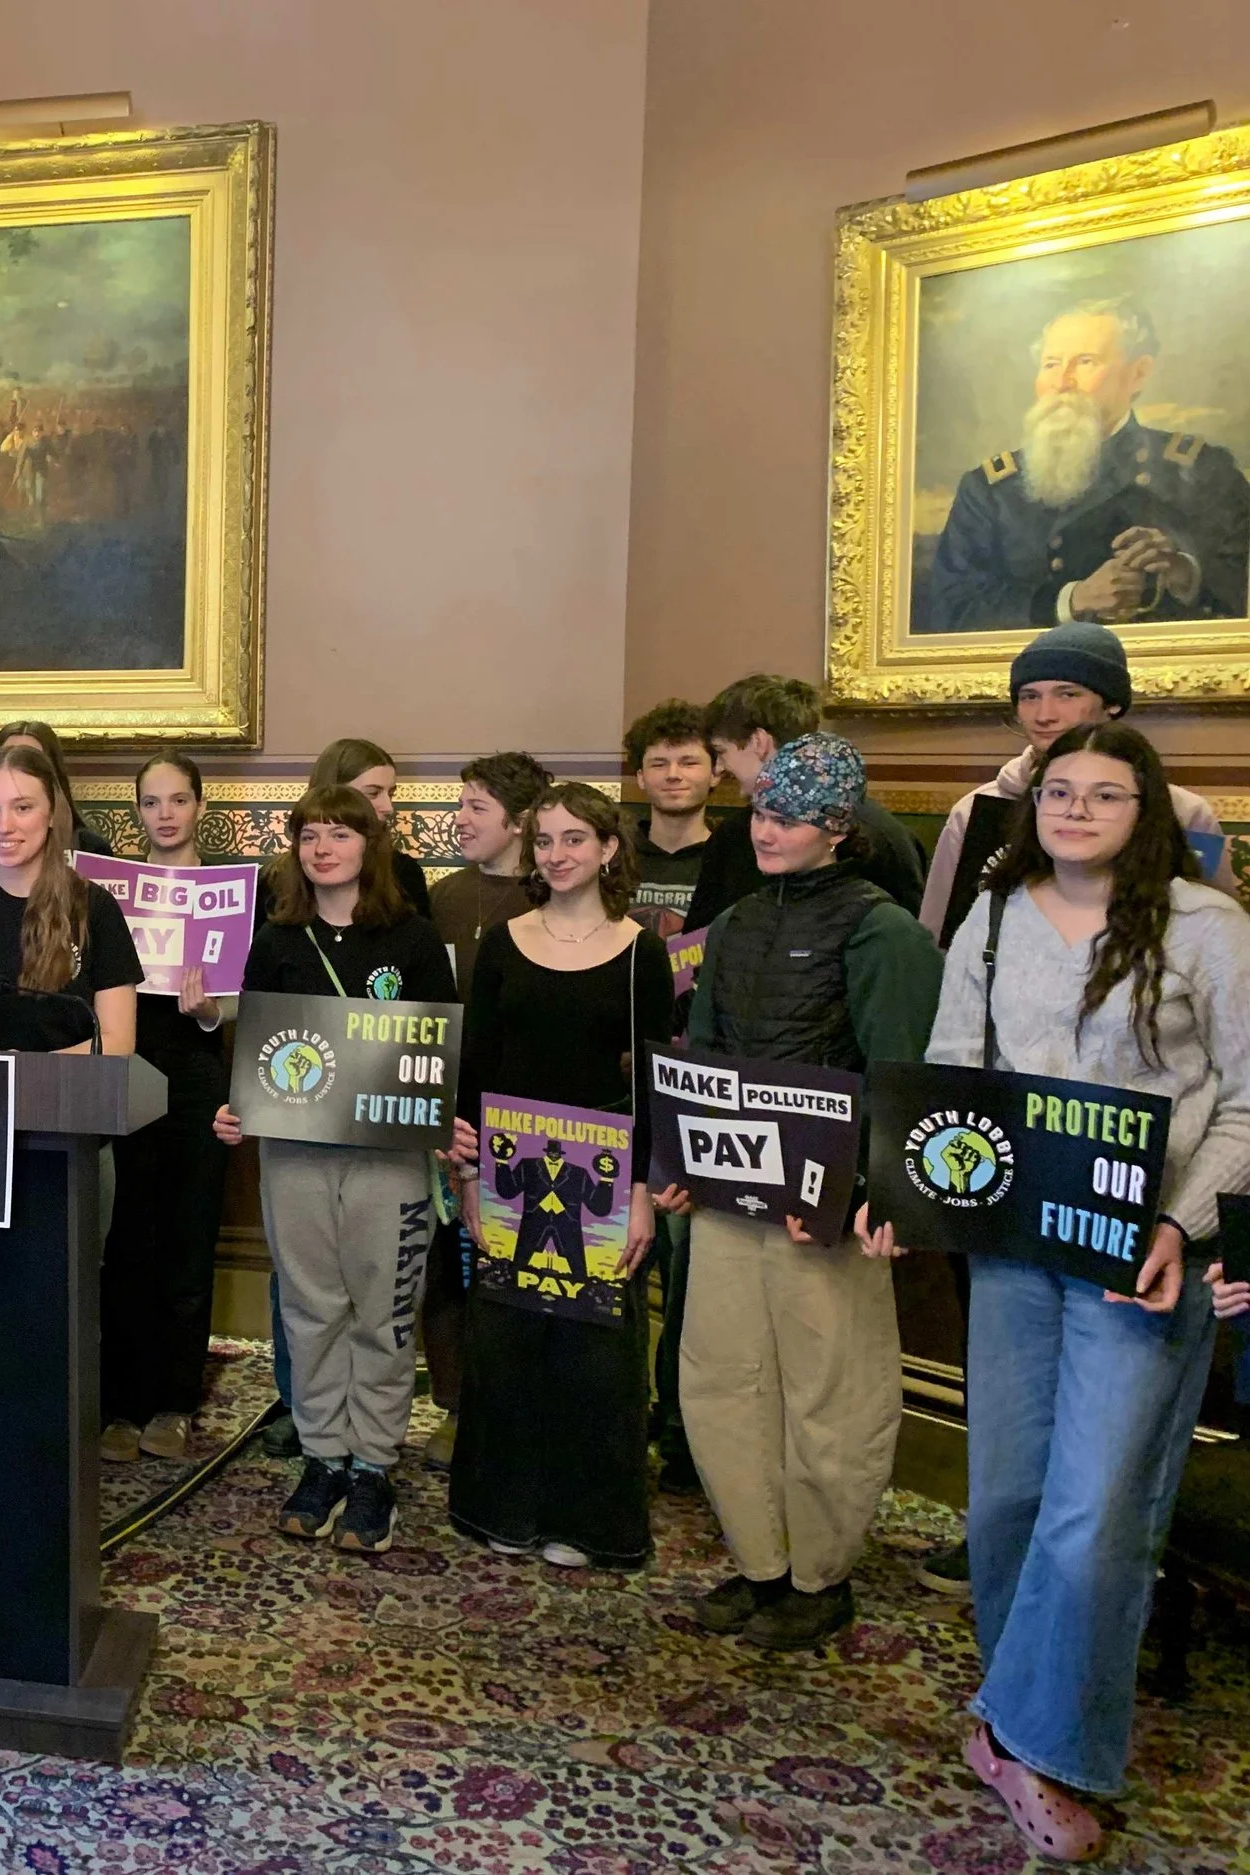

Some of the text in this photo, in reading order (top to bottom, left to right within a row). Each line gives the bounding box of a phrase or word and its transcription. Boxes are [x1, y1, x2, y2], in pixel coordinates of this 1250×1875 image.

[140, 882, 188, 907] BIG
[198, 888, 240, 911] OIL
[131, 927, 176, 955] AY
[257, 1028, 337, 1069] YOUTH LOBBY
[346, 1012, 449, 1046] PROTECT
[257, 1066, 336, 1104] CLIMATE JOBS JUSTICE
[398, 1054, 445, 1085] OUR
[658, 1063, 849, 1115] MAKE POLLUTERS
[354, 1093, 443, 1127] FUTURE
[485, 1106, 630, 1150] MAKE POLLUTERS
[1025, 1092, 1154, 1150] PROTECT
[688, 1128, 768, 1170] PAY
[904, 1110, 1014, 1166] YOUTH LOBBY
[905, 1157, 1014, 1208] CLIMATE JOBS JUSTICE
[1092, 1156, 1147, 1206] OUR
[1040, 1201, 1140, 1262] FUTURE
[517, 1270, 585, 1300] PAY
